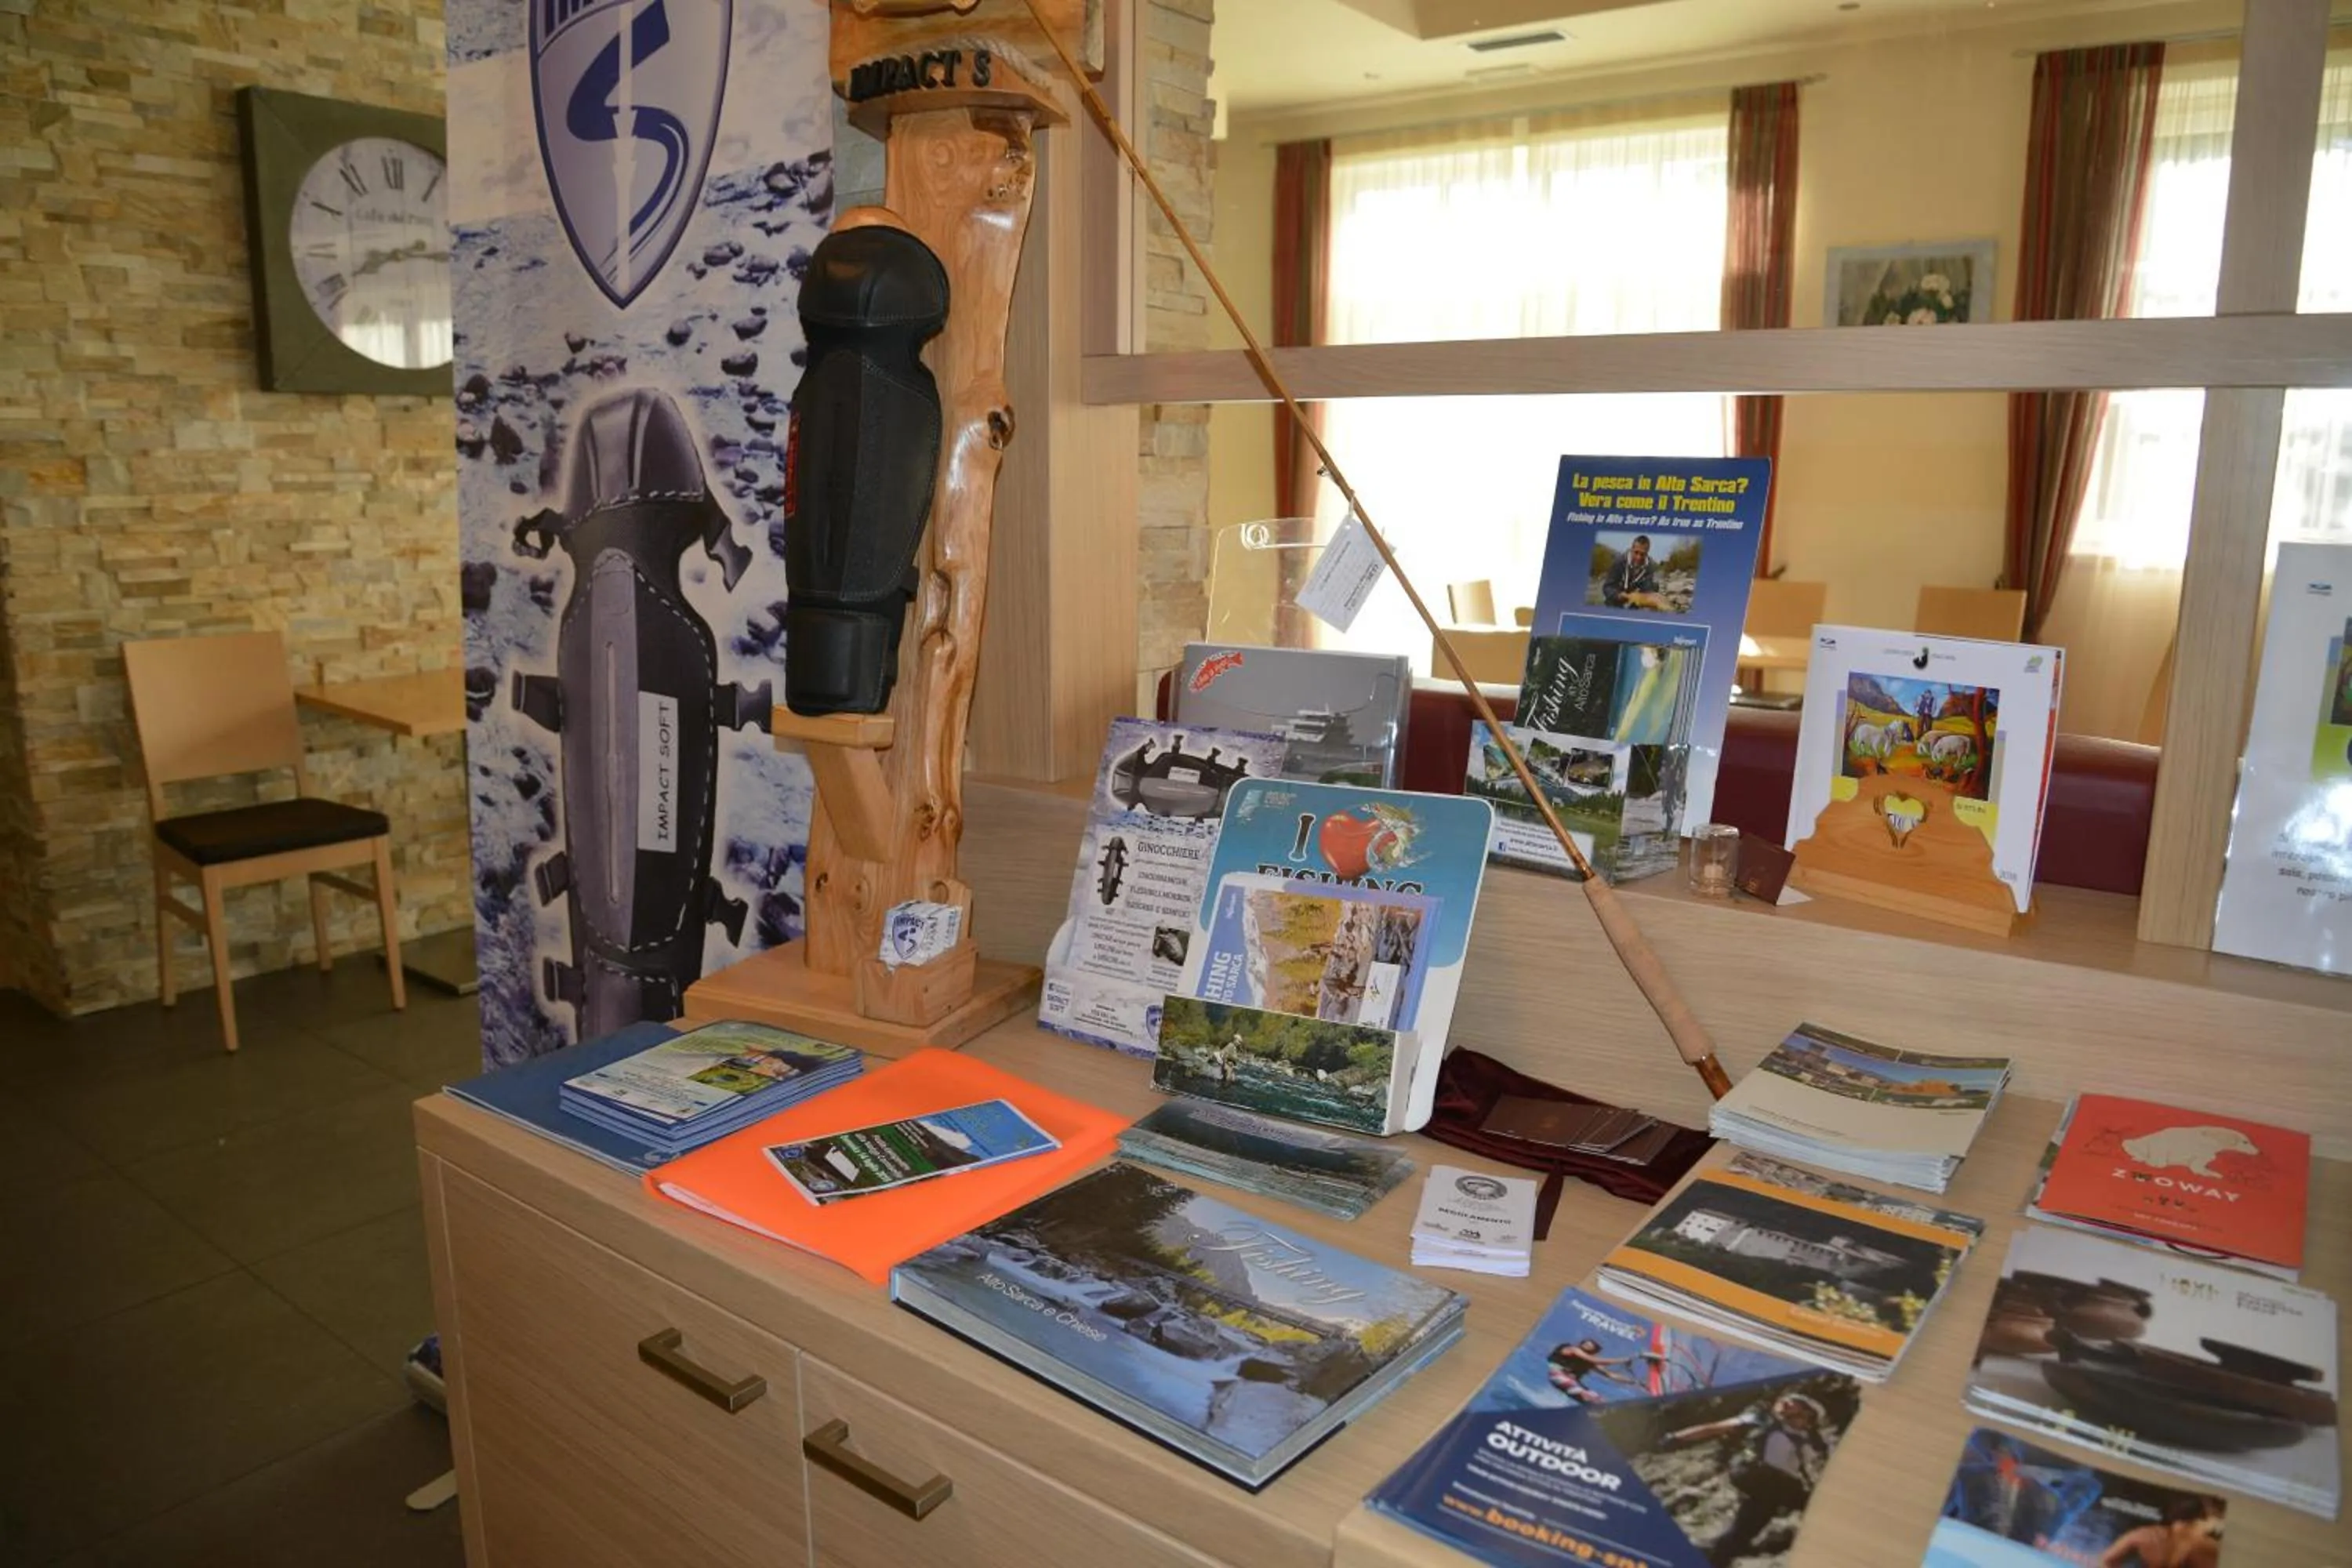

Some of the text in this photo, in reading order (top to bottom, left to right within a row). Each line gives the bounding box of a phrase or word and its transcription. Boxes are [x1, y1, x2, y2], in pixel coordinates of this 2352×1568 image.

[1573, 473, 1748, 494] La pesca in Alto Sarca?
[1579, 492, 1736, 514] Vera come il Trentino
[1567, 512, 1744, 530] Fishing in Alto Sarca? As true as Trentino
[1525, 649, 1579, 732] Fishing
[658, 702, 671, 841] IMPACT SOFT
[1137, 840, 1201, 860] GINOCCHIERE
[1288, 813, 1316, 862] I
[1192, 1223, 1366, 1305] Fishing
[976, 1273, 1006, 1291] Alto
[1003, 1284, 1045, 1312] Sarca
[1043, 1307, 1057, 1316] e
[1486, 1432, 1623, 1491] OUTDOOR
[1495, 1420, 1588, 1465] ATTIVITÀ
